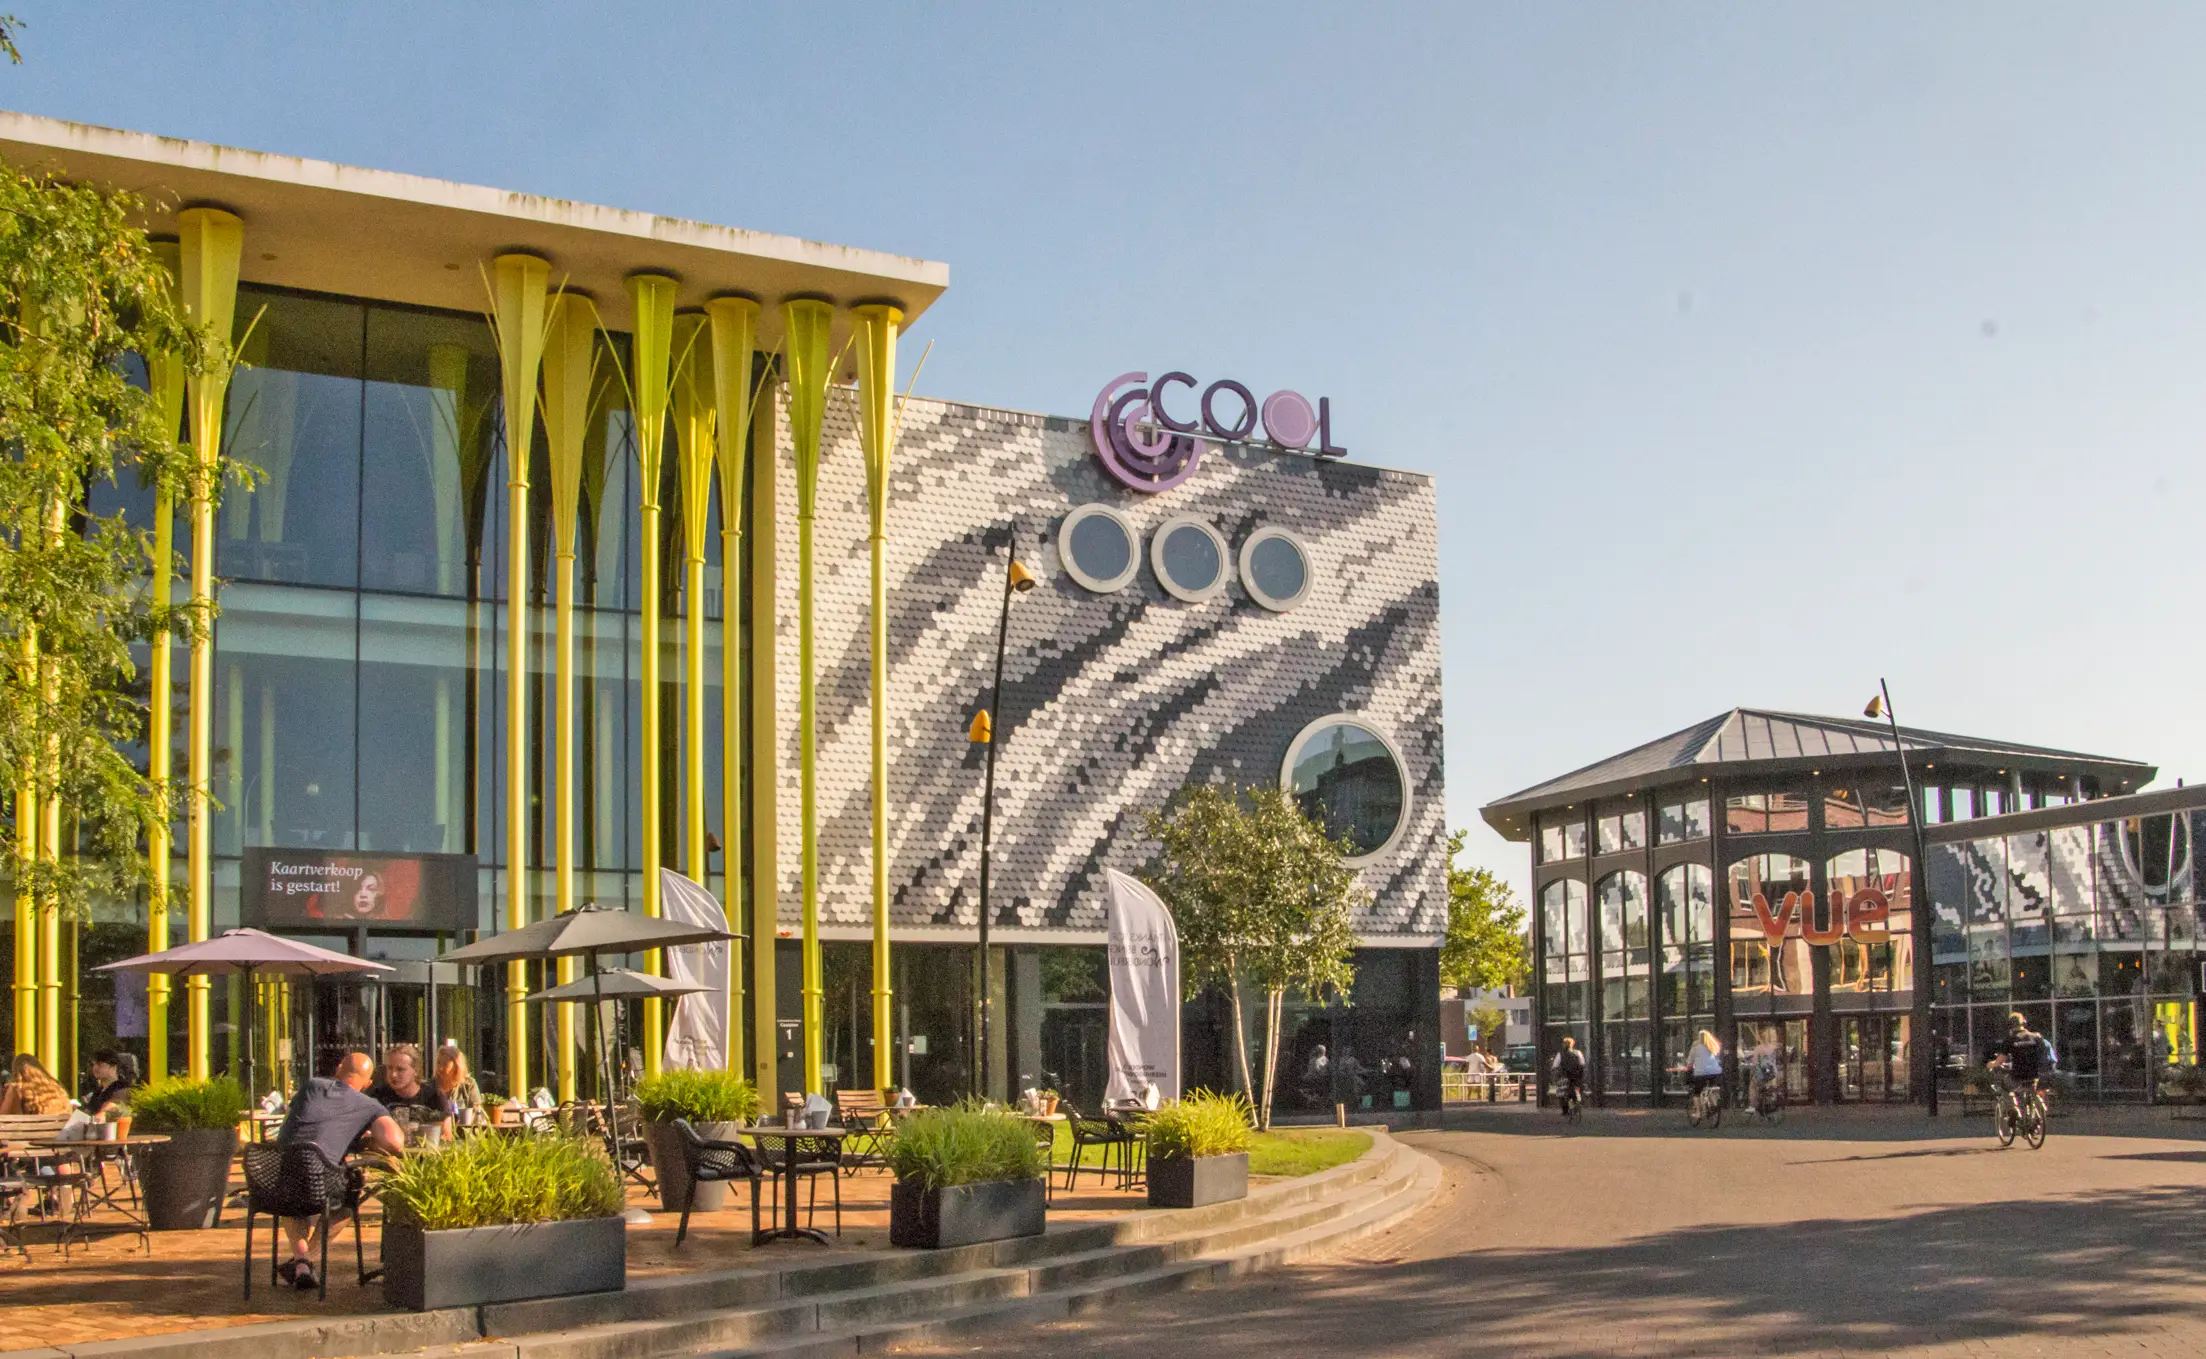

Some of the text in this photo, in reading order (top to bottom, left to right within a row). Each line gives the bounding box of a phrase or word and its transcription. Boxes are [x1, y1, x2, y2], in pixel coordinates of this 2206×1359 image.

[1151, 371, 1347, 457] COOL
[271, 861, 363, 880] Kaartverkoop
[271, 879, 340, 895] is gestart!
[1752, 887, 1891, 947] vue
[786, 1029, 792, 1040] 1
